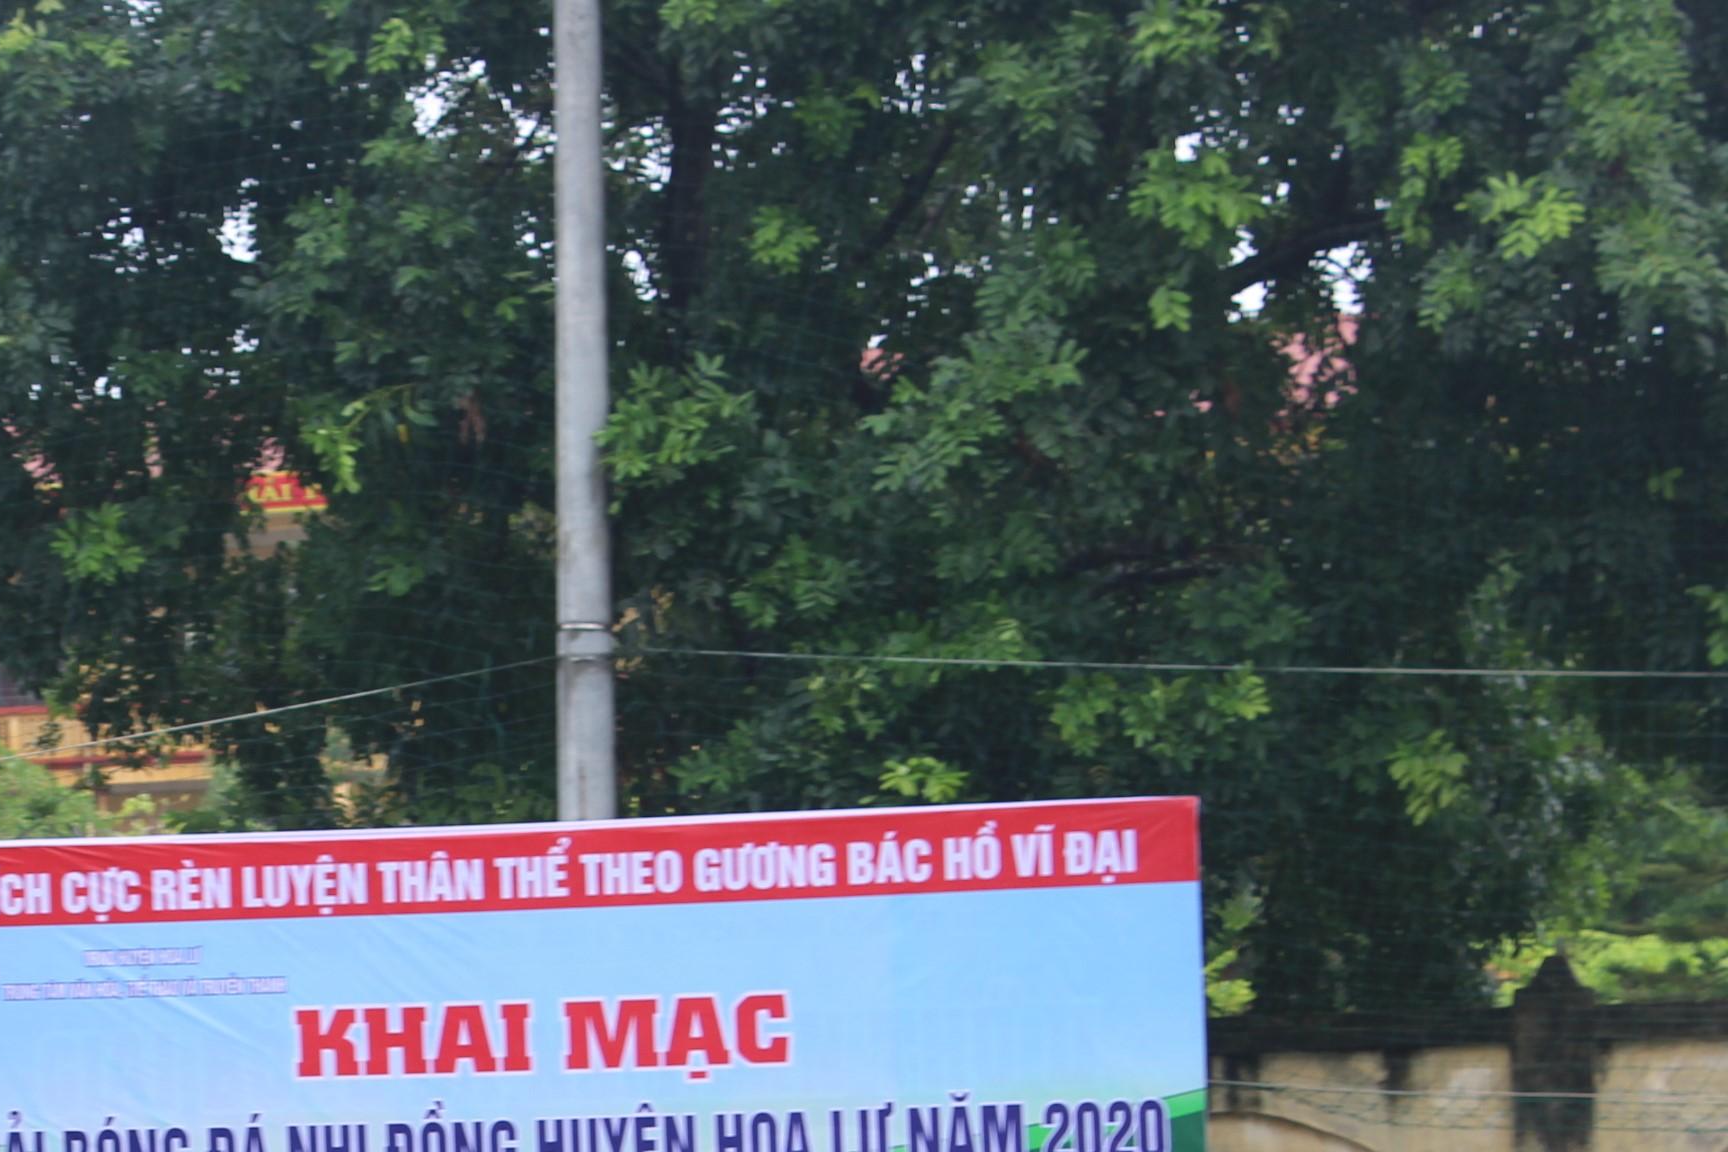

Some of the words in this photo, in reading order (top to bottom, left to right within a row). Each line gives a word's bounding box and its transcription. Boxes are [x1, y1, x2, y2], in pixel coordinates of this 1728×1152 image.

[62, 865, 141, 922] CỰC
[152, 859, 231, 911] RÈN
[243, 855, 367, 916] LUYỆN
[378, 851, 484, 903] THÂN
[493, 836, 571, 899] THỂ
[583, 851, 681, 896] THEO
[693, 840, 834, 892] GƯƠNG
[847, 831, 932, 885] BÁC
[943, 820, 1002, 881] HỒ
[1010, 826, 1054, 877] VĨ
[1063, 829, 1137, 885] ĐẠI
[295, 1001, 532, 1078] KHAI
[563, 991, 791, 1080] MẠC
